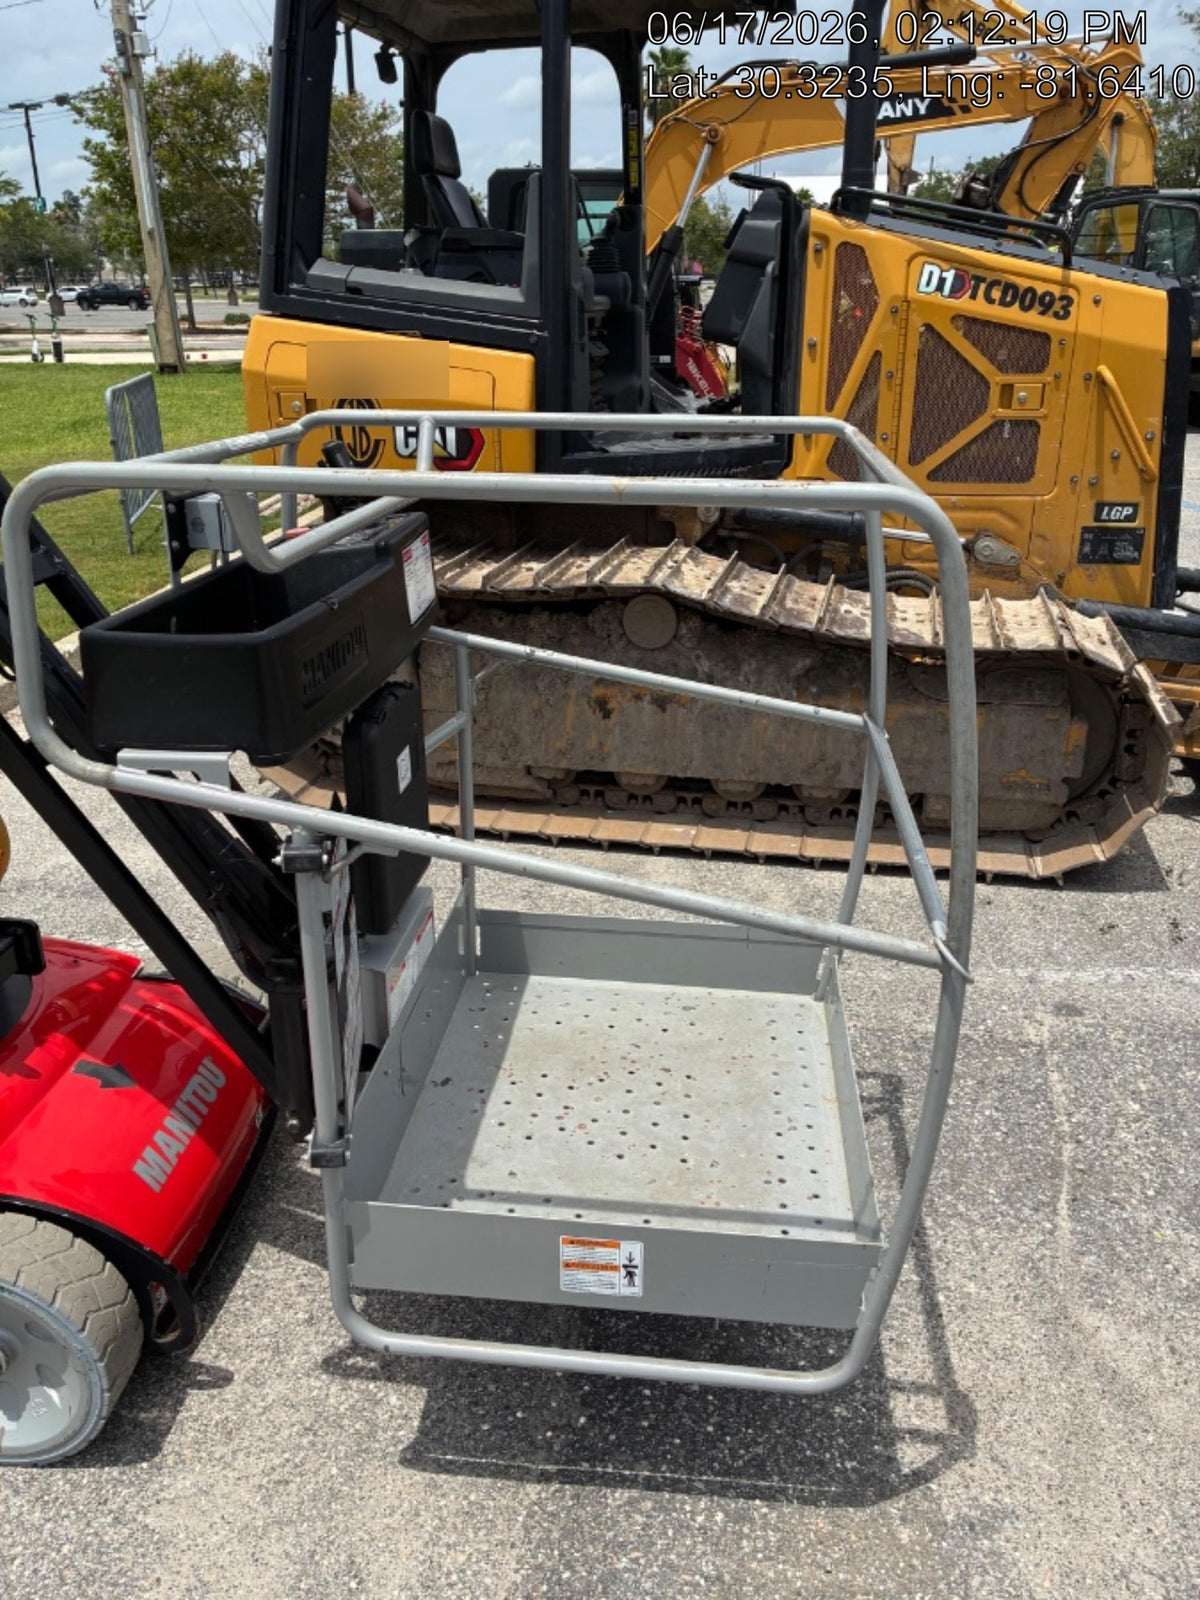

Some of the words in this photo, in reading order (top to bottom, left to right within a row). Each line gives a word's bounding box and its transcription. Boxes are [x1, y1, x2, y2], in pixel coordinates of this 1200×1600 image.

[877, 97, 932, 120] ANY
[968, 274, 1075, 321] TCD093
[686, 357, 716, 399] TAKEU
[1100, 506, 1134, 521] LGP
[132, 1056, 227, 1194] MANITOU
